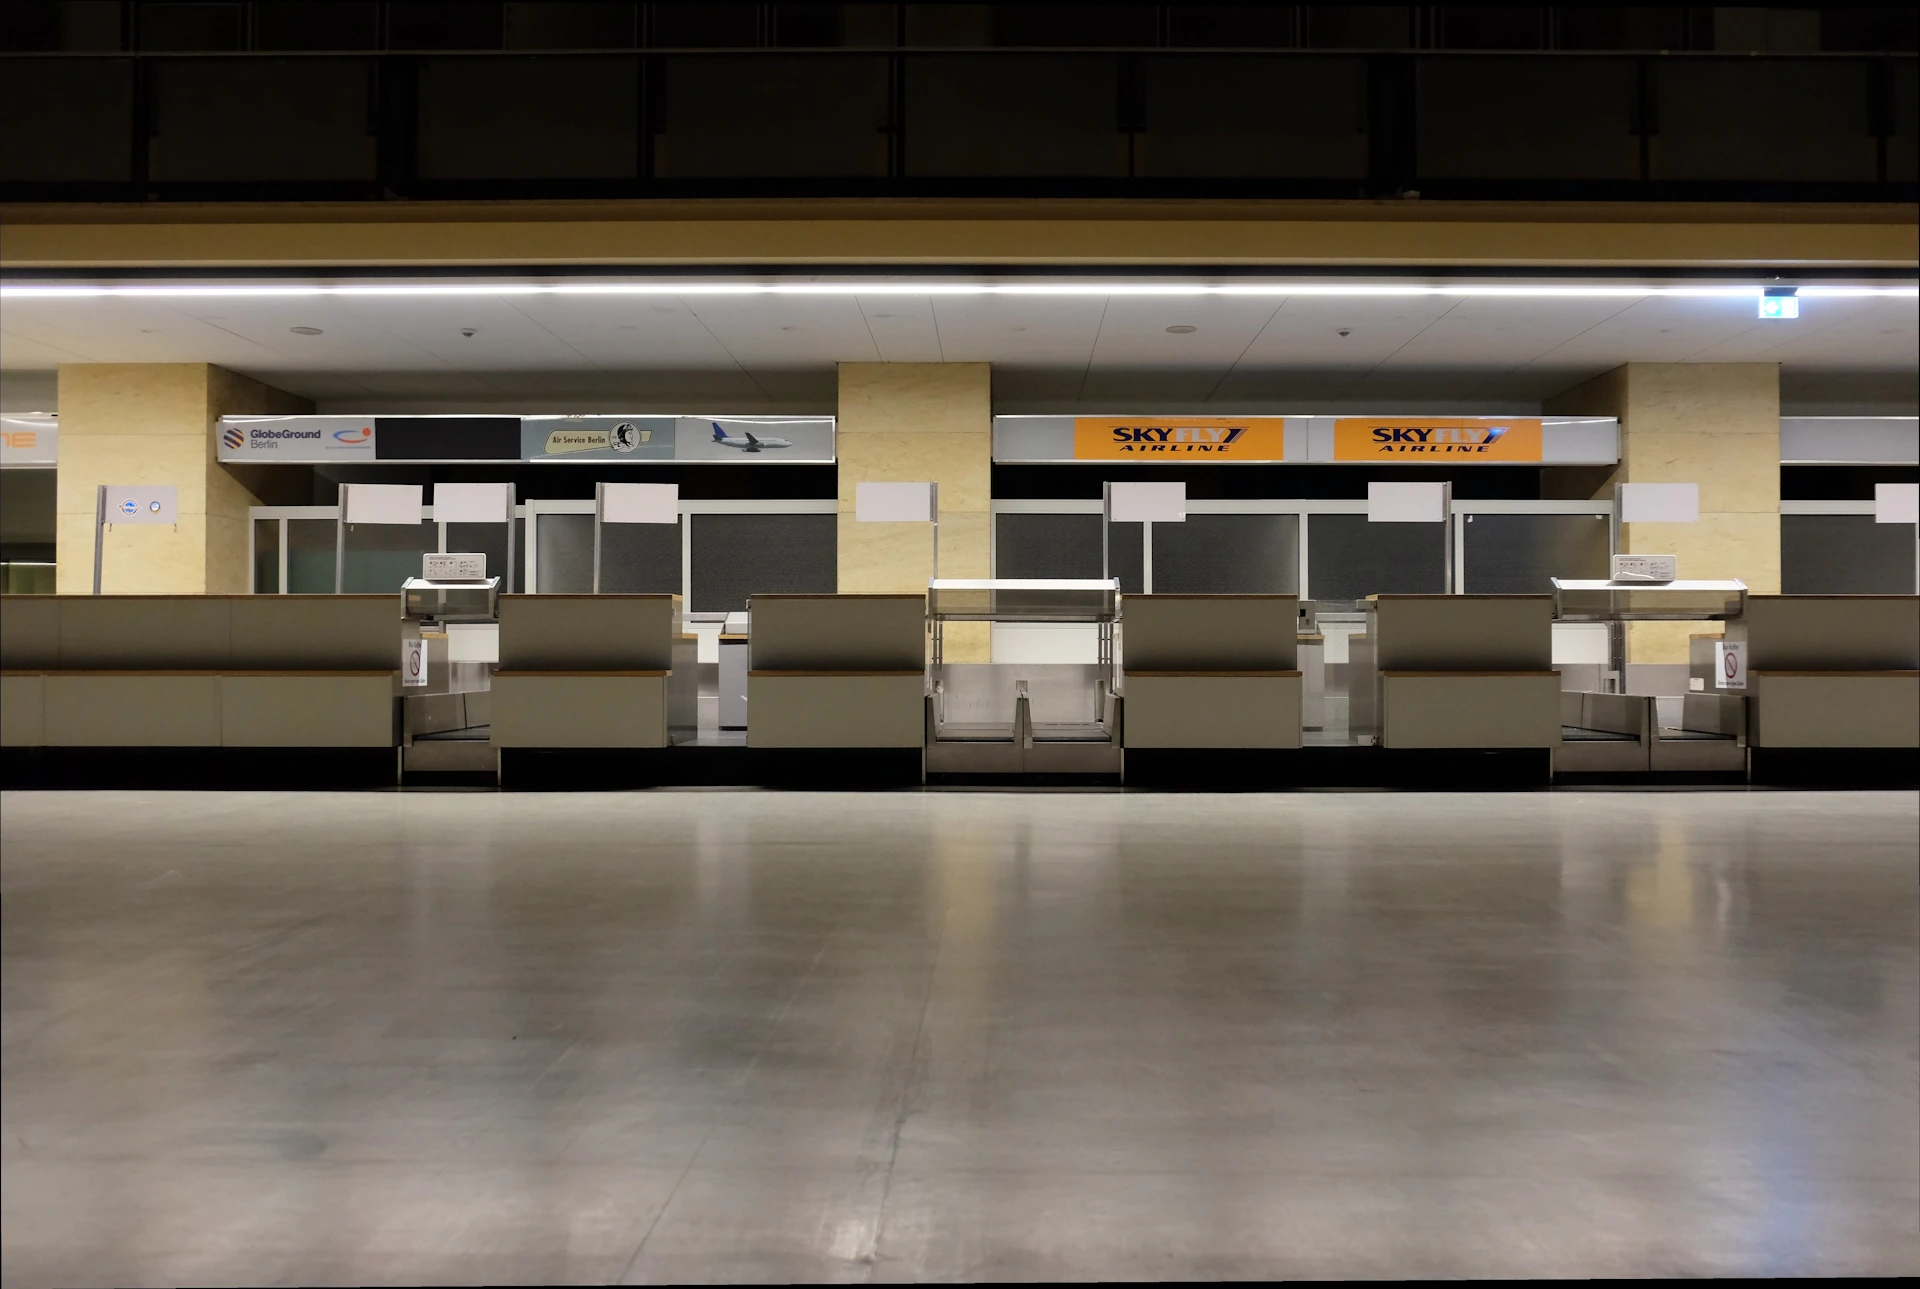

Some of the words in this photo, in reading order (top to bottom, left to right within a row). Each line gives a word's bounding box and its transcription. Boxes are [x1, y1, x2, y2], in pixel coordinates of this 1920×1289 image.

[250, 429, 321, 439] GlobeGround
[250, 440, 278, 449] Berlin
[552, 436, 562, 444] Air
[563, 436, 586, 444] Service
[587, 436, 606, 444] Berlin
